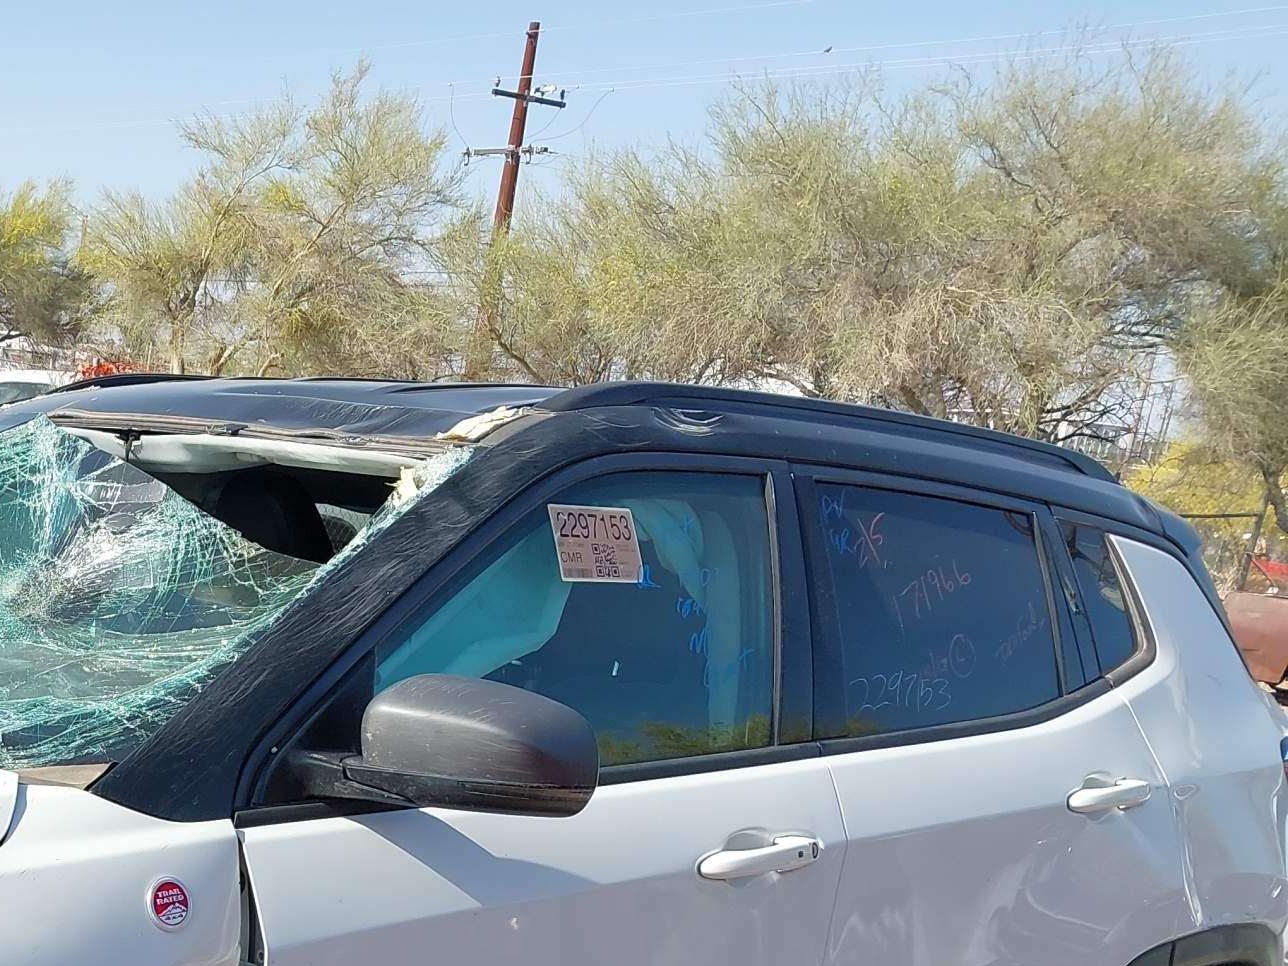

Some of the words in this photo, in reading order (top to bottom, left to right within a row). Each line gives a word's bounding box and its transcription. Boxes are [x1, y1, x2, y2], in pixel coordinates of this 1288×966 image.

[556, 511, 632, 542] 2297153
[156, 888, 183, 898] TRAIL
[156, 895, 184, 905] RATED
